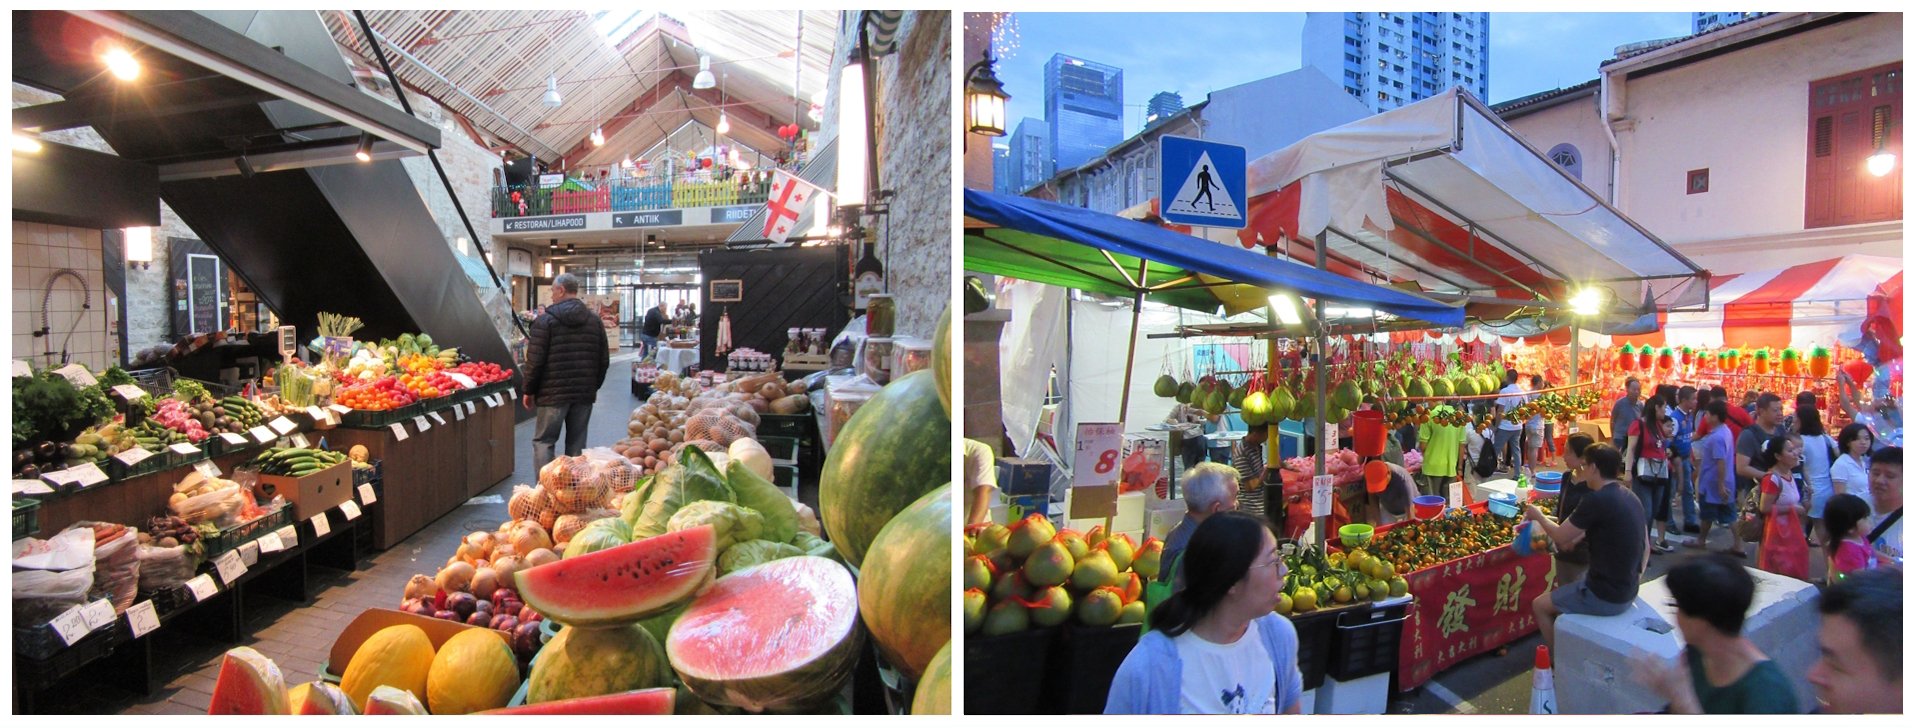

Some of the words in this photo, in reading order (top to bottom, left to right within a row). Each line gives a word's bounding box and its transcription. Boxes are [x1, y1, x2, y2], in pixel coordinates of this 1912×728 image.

[513, 217, 584, 230] RESTORAN/LIHAPOOD
[633, 213, 660, 225] ANTIIK
[1094, 449, 1119, 474] 8
[1442, 554, 1486, 578] 大吉大利
[1413, 596, 1423, 660] 大吉大利
[1437, 636, 1478, 664] 大吉大利
